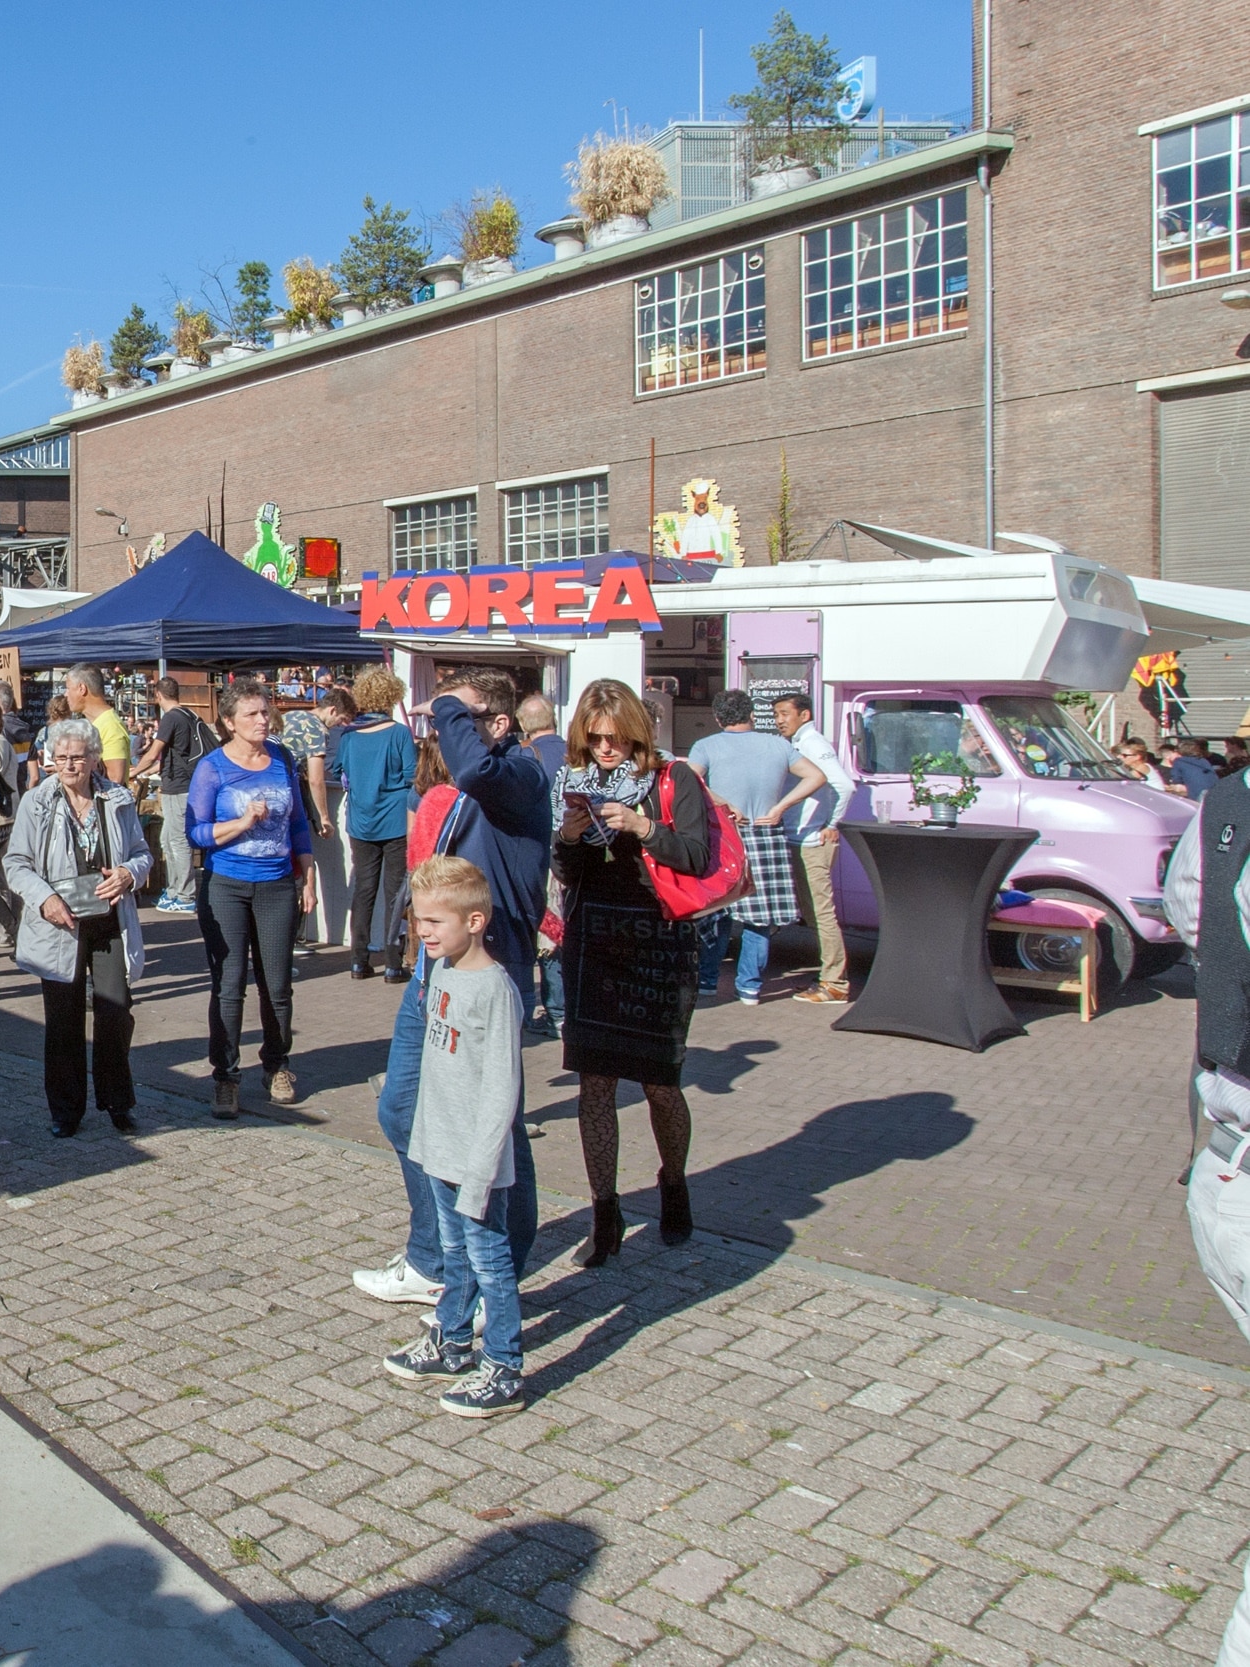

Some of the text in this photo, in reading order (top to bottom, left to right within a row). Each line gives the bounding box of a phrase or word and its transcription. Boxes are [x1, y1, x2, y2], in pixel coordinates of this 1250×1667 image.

[360, 557, 663, 636] KOREA
[752, 689, 779, 697] KOREAN
[602, 978, 680, 1004] STUDIO
